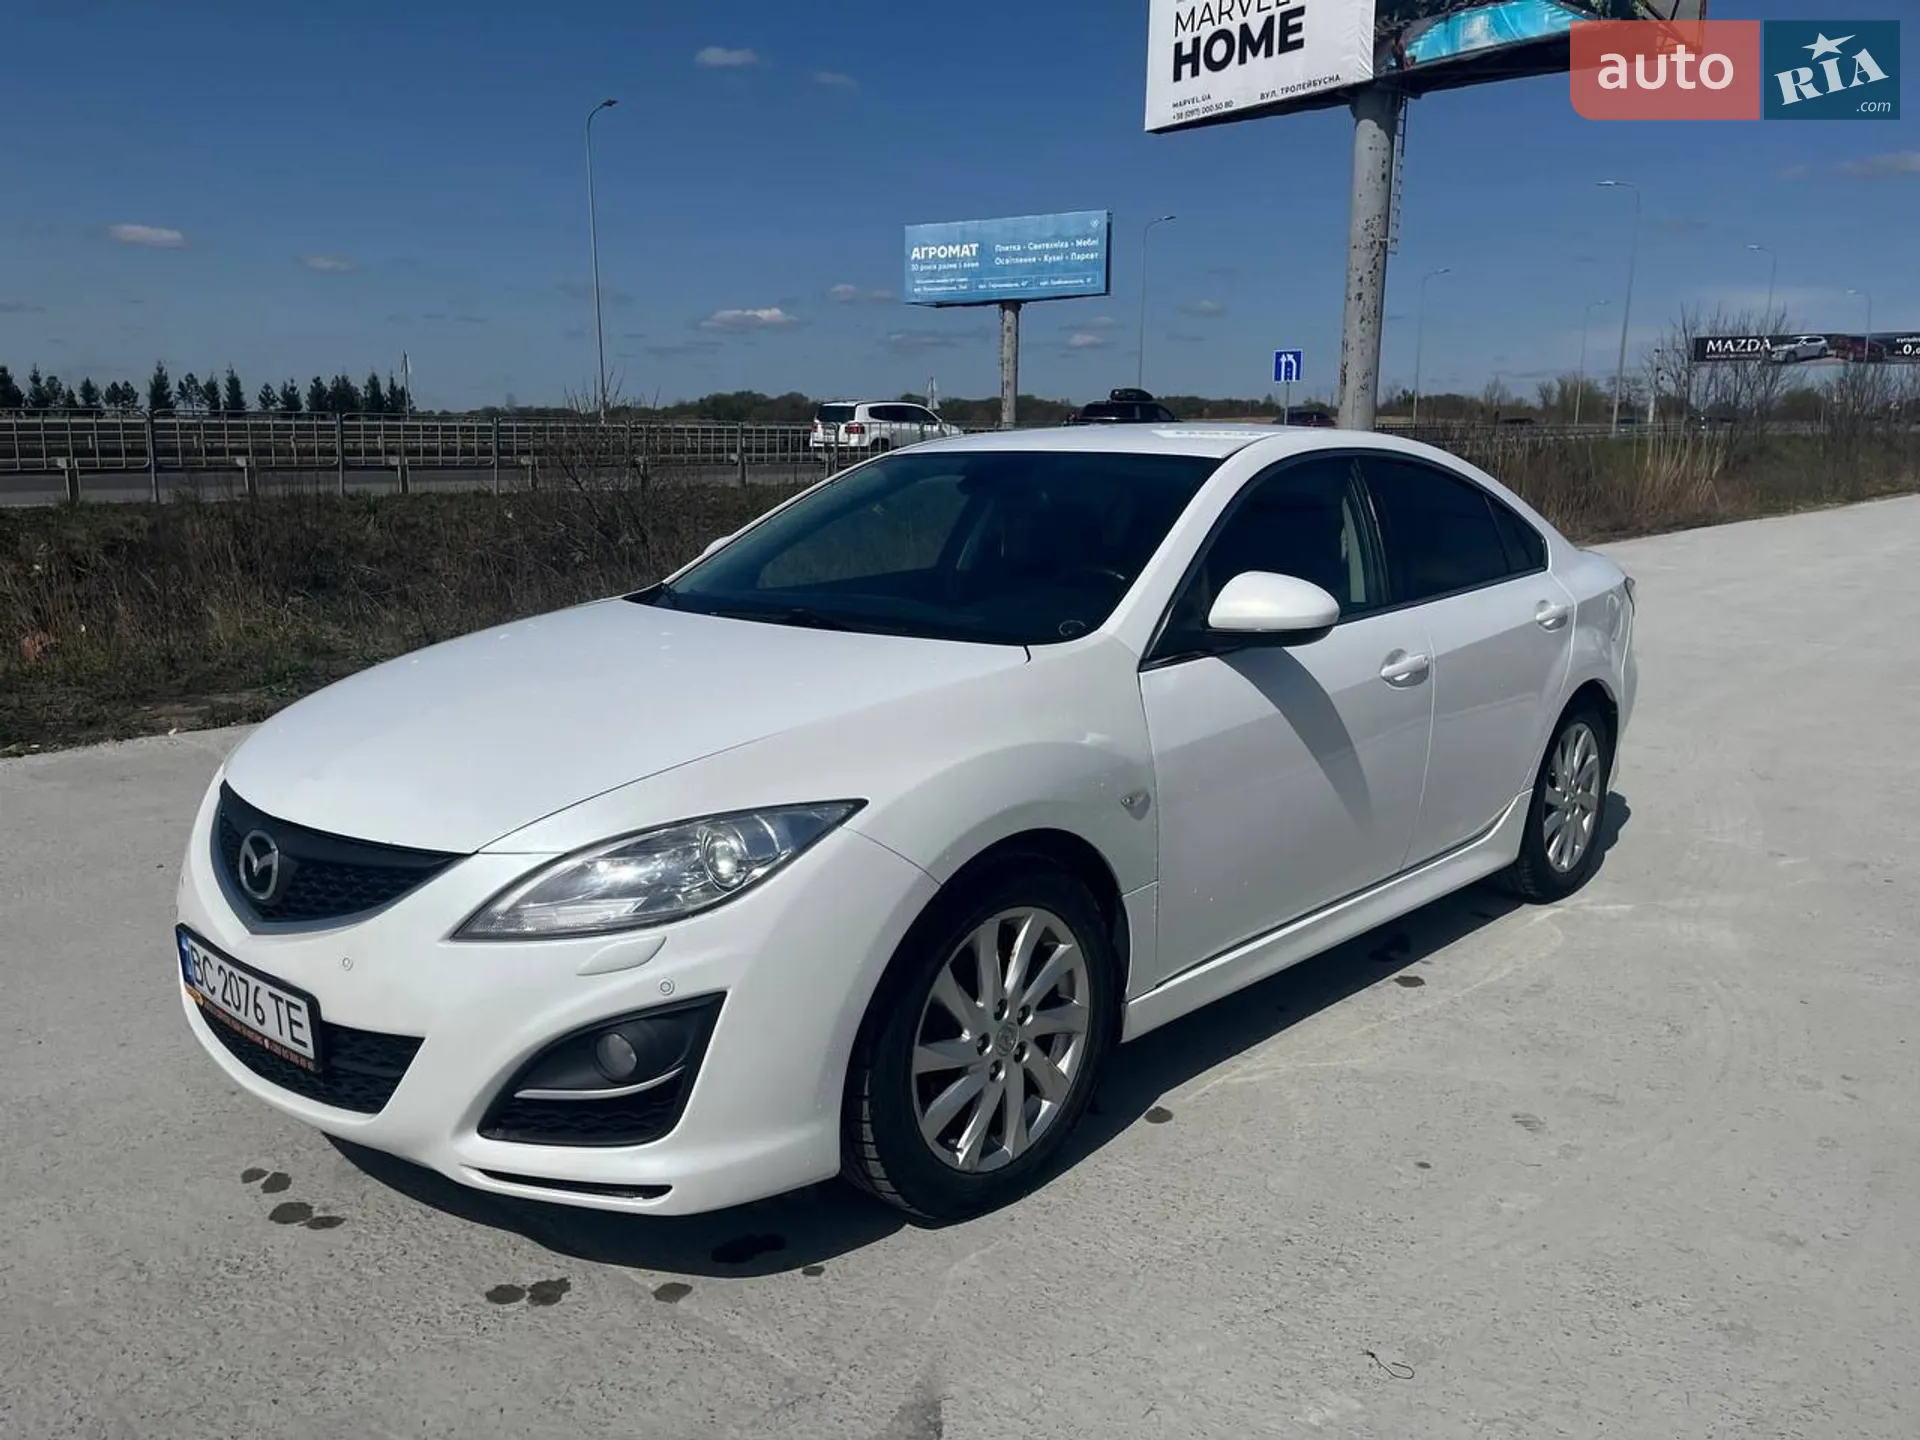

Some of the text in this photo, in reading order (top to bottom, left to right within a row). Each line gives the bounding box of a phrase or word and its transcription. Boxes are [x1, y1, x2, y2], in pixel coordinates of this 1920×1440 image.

[1174, 0, 1291, 38] MARV
[1173, 5, 1306, 83] HOME
[911, 243, 979, 260] АГРОМАТ
[1706, 338, 1771, 353] MAZDA
[190, 944, 216, 996] BC
[217, 965, 265, 1027] 2076
[268, 991, 308, 1048] TE
